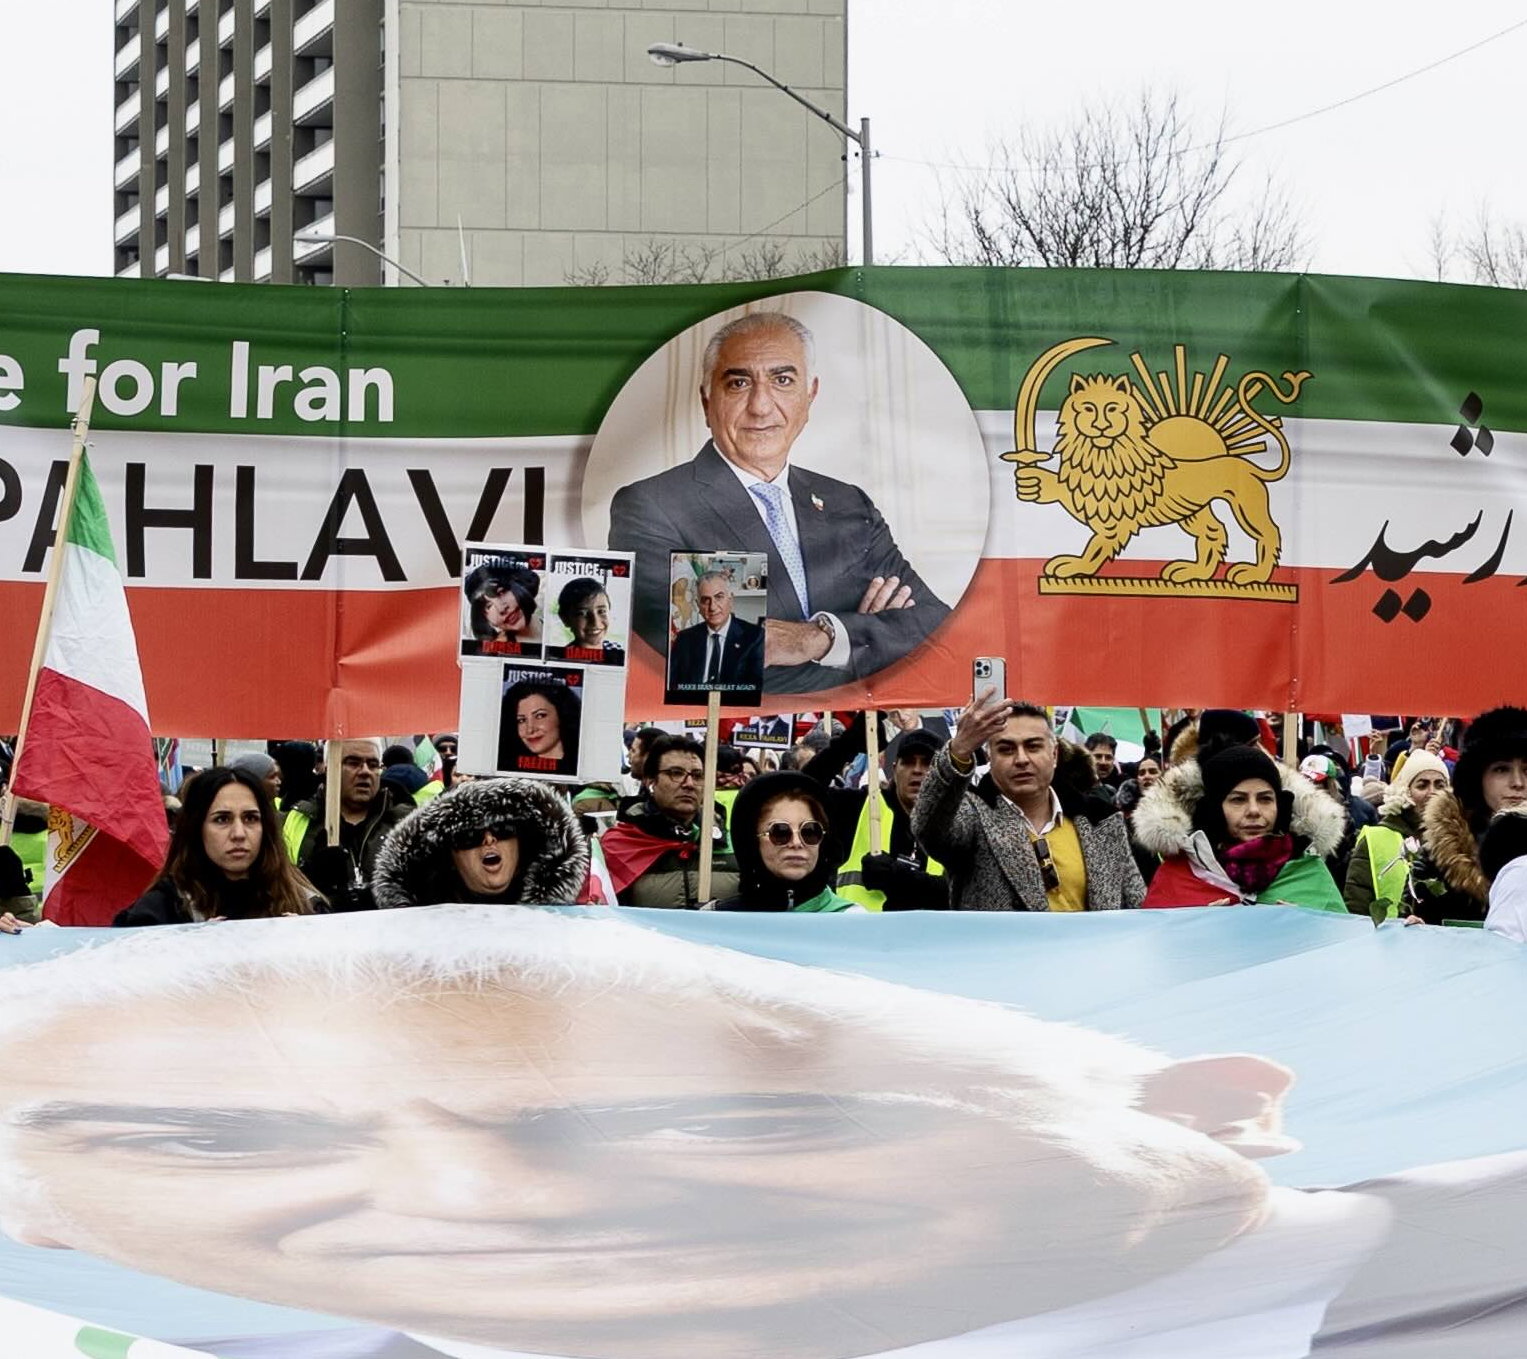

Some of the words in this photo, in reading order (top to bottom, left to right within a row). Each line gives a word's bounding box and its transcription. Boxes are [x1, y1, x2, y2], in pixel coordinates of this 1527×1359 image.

[58, 328, 197, 417] for
[229, 341, 394, 422] Iran
[553, 561, 600, 577] JUSTICE
